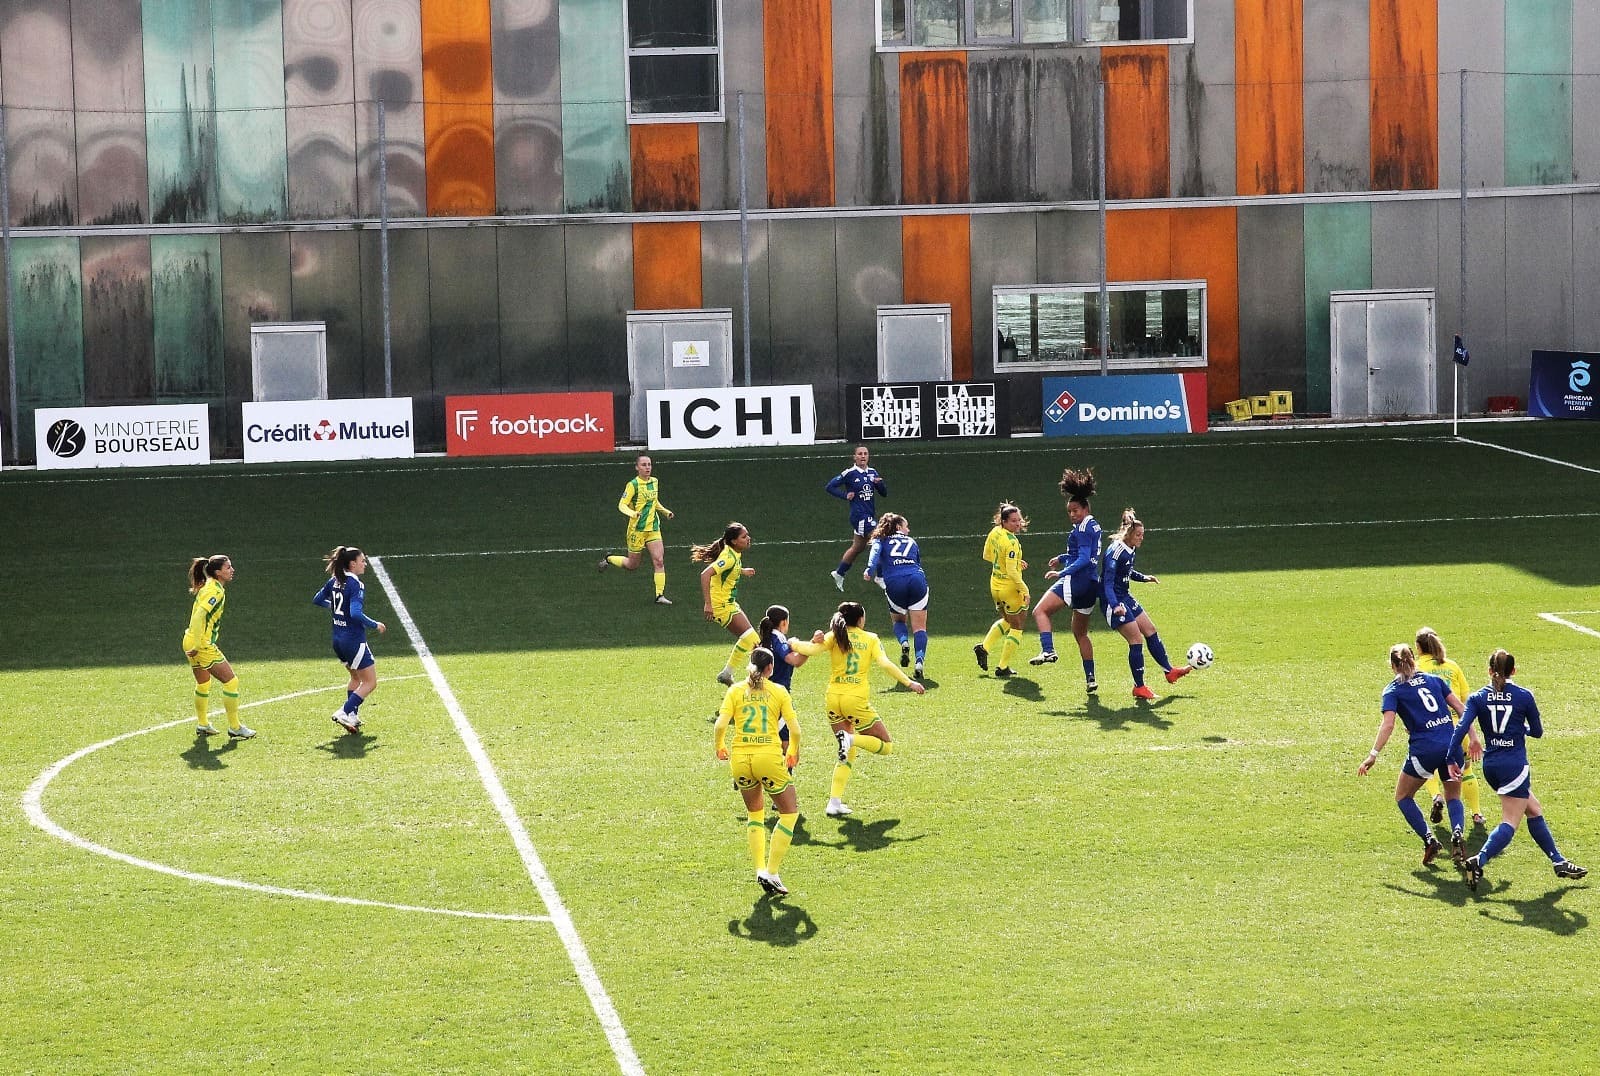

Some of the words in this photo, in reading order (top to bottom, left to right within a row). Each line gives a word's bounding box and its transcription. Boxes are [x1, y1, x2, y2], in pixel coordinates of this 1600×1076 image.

[874, 398, 920, 413] BELLE
[948, 396, 995, 411] BELLE
[1078, 400, 1182, 422] Domino's
[94, 419, 200, 438] MINOTERIE
[490, 413, 604, 439] footpack.
[659, 396, 802, 439] ICHI
[247, 423, 311, 443] Crédit
[339, 420, 410, 440] Mutuel
[883, 424, 920, 438] 1877
[958, 422, 995, 436] 1877
[95, 436, 200, 454] BOURSEAU
[889, 538, 914, 557] 27
[332, 590, 344, 616] 12
[845, 652, 860, 675] 6
[1417, 687, 1439, 712] 6
[1487, 692, 1513, 701] EVELS
[742, 705, 768, 733] 21
[1486, 704, 1513, 734] 17
